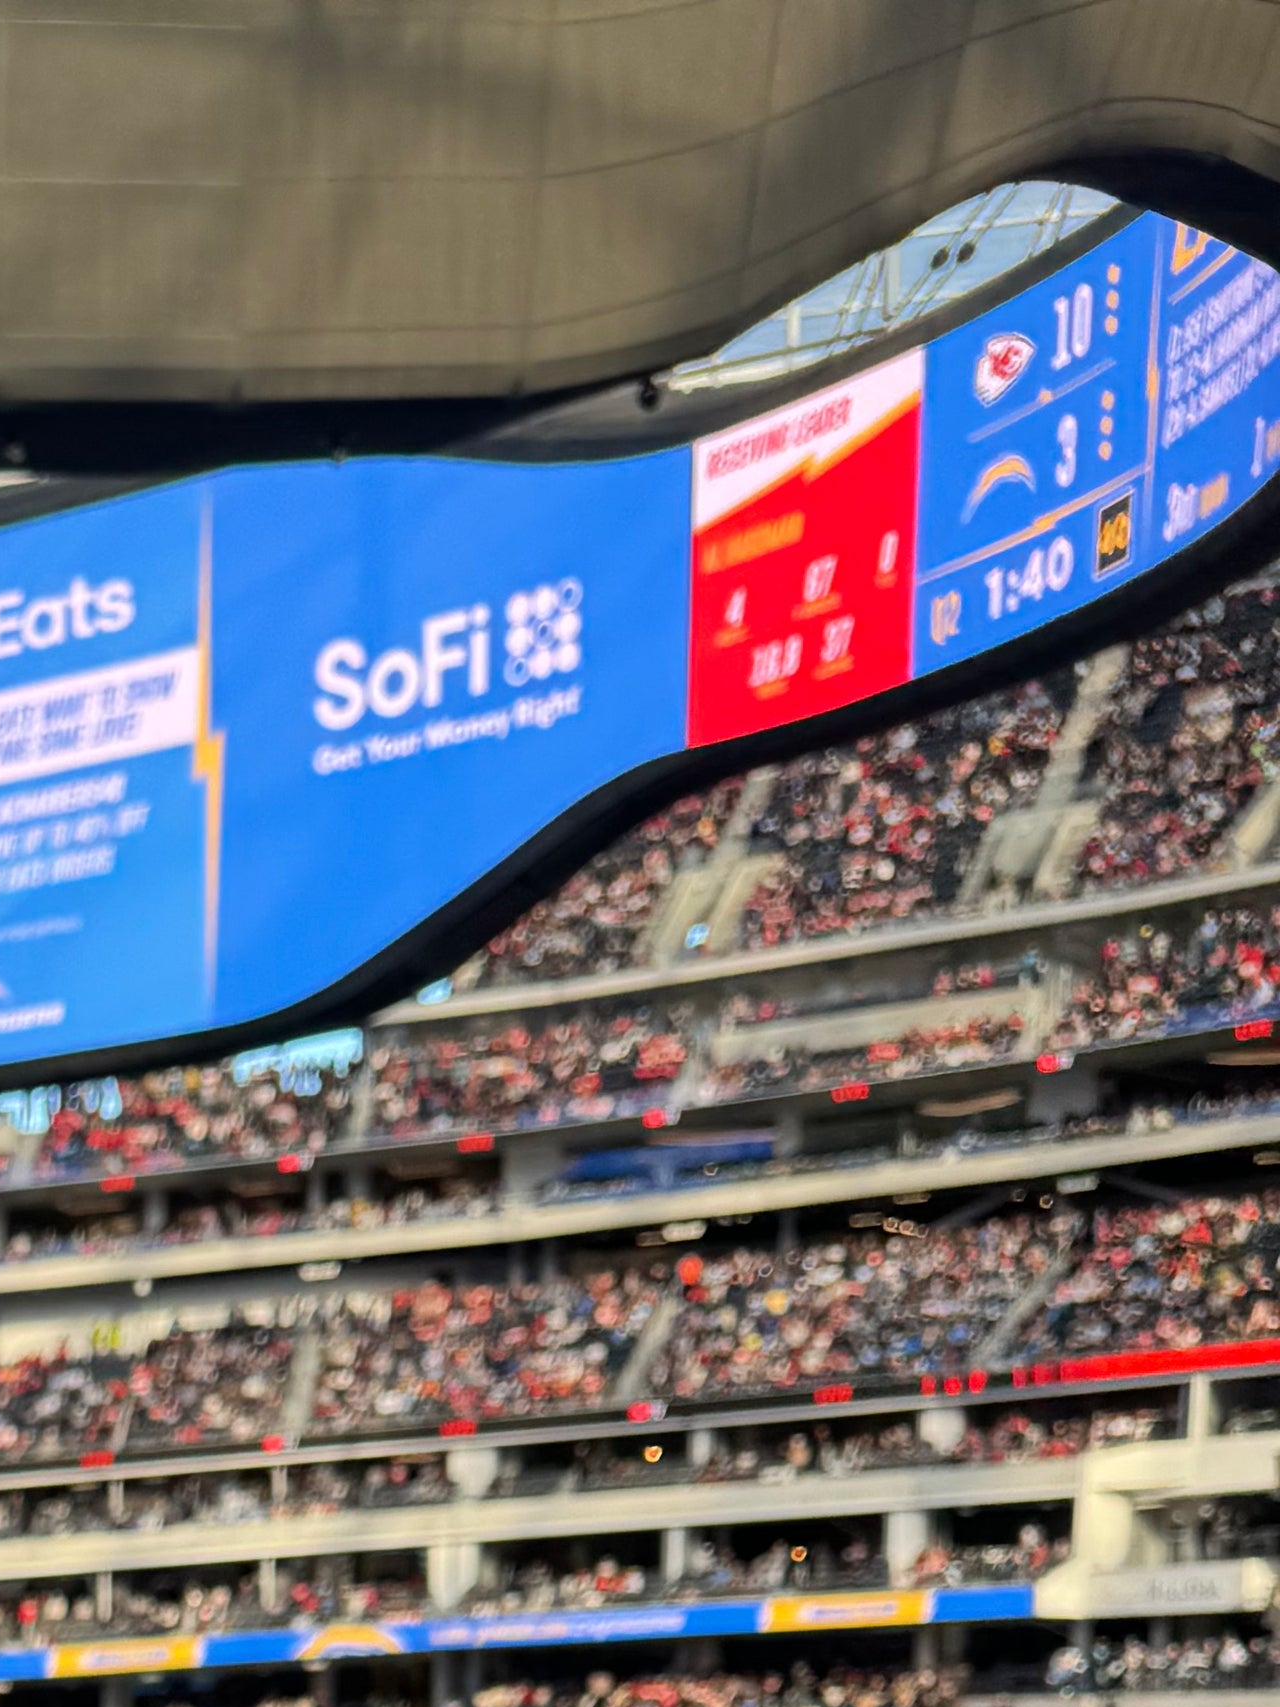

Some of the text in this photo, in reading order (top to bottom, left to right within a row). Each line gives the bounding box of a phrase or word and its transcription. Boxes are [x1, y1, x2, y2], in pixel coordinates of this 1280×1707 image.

[1050, 282, 1095, 371] 10
[1054, 413, 1078, 488] 3
[984, 535, 1074, 620] 1:40
[312, 602, 491, 731] SoFi
[312, 684, 584, 776] Get Your Money Right
